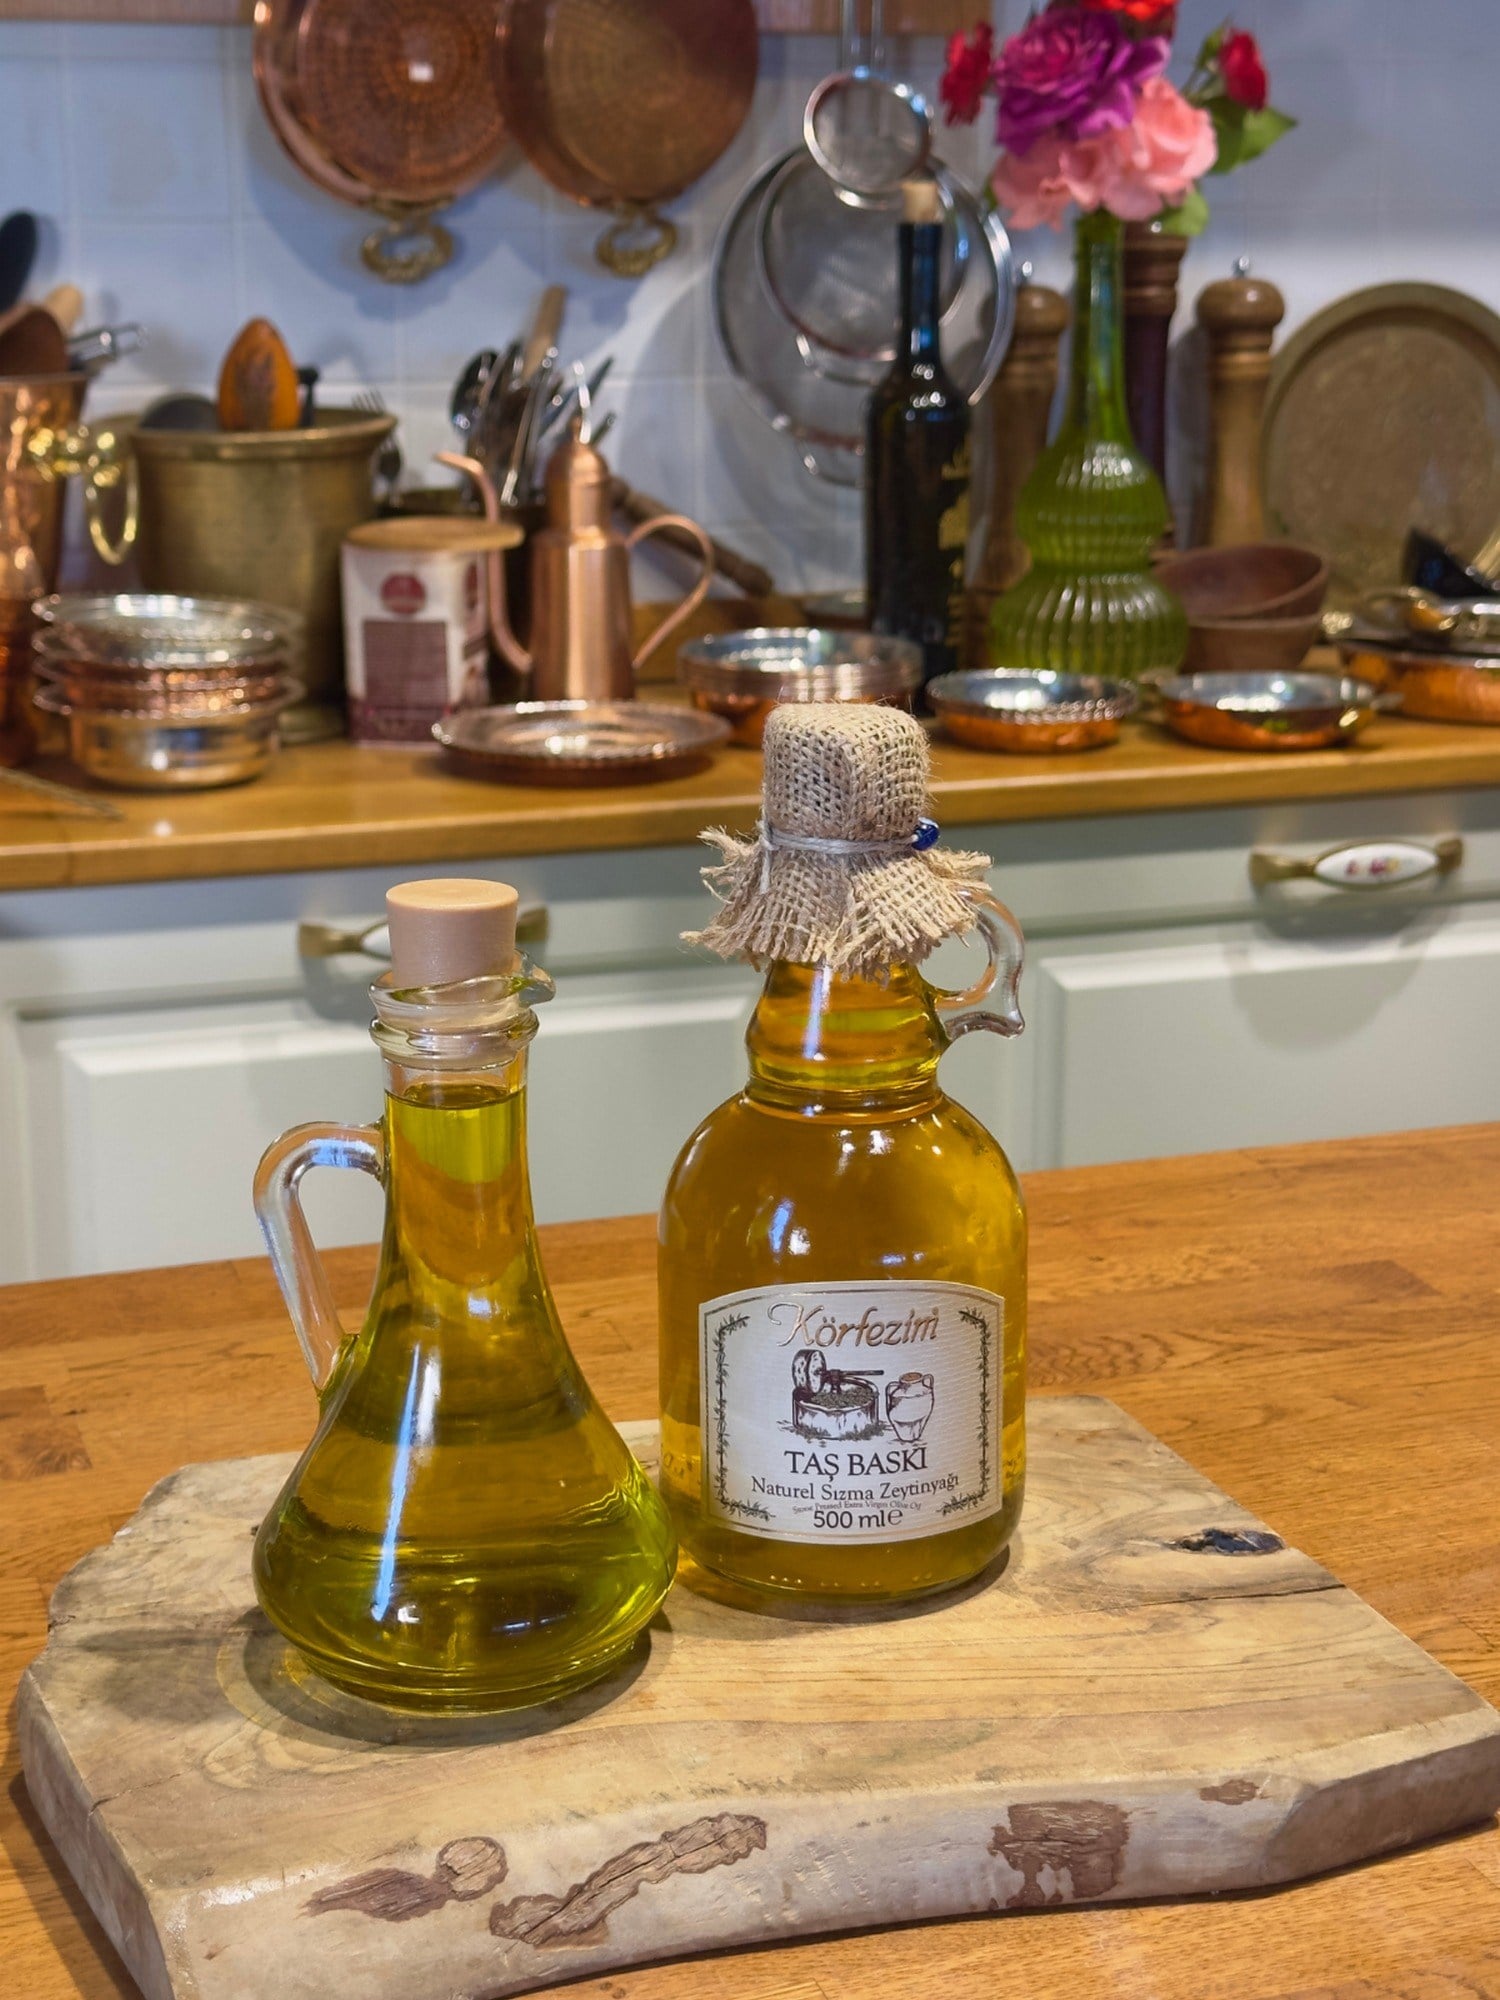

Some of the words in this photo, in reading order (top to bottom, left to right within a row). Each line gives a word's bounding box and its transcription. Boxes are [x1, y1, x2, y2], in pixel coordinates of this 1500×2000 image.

[767, 1301, 939, 1347] Körfezim
[784, 1451, 840, 1482] TAŞ
[847, 1446, 928, 1476] BASKI
[751, 1475, 815, 1500] Naturel
[821, 1484, 875, 1501] Sızma
[880, 1473, 959, 1501] Zeytinyağı
[813, 1510, 853, 1529] 500
